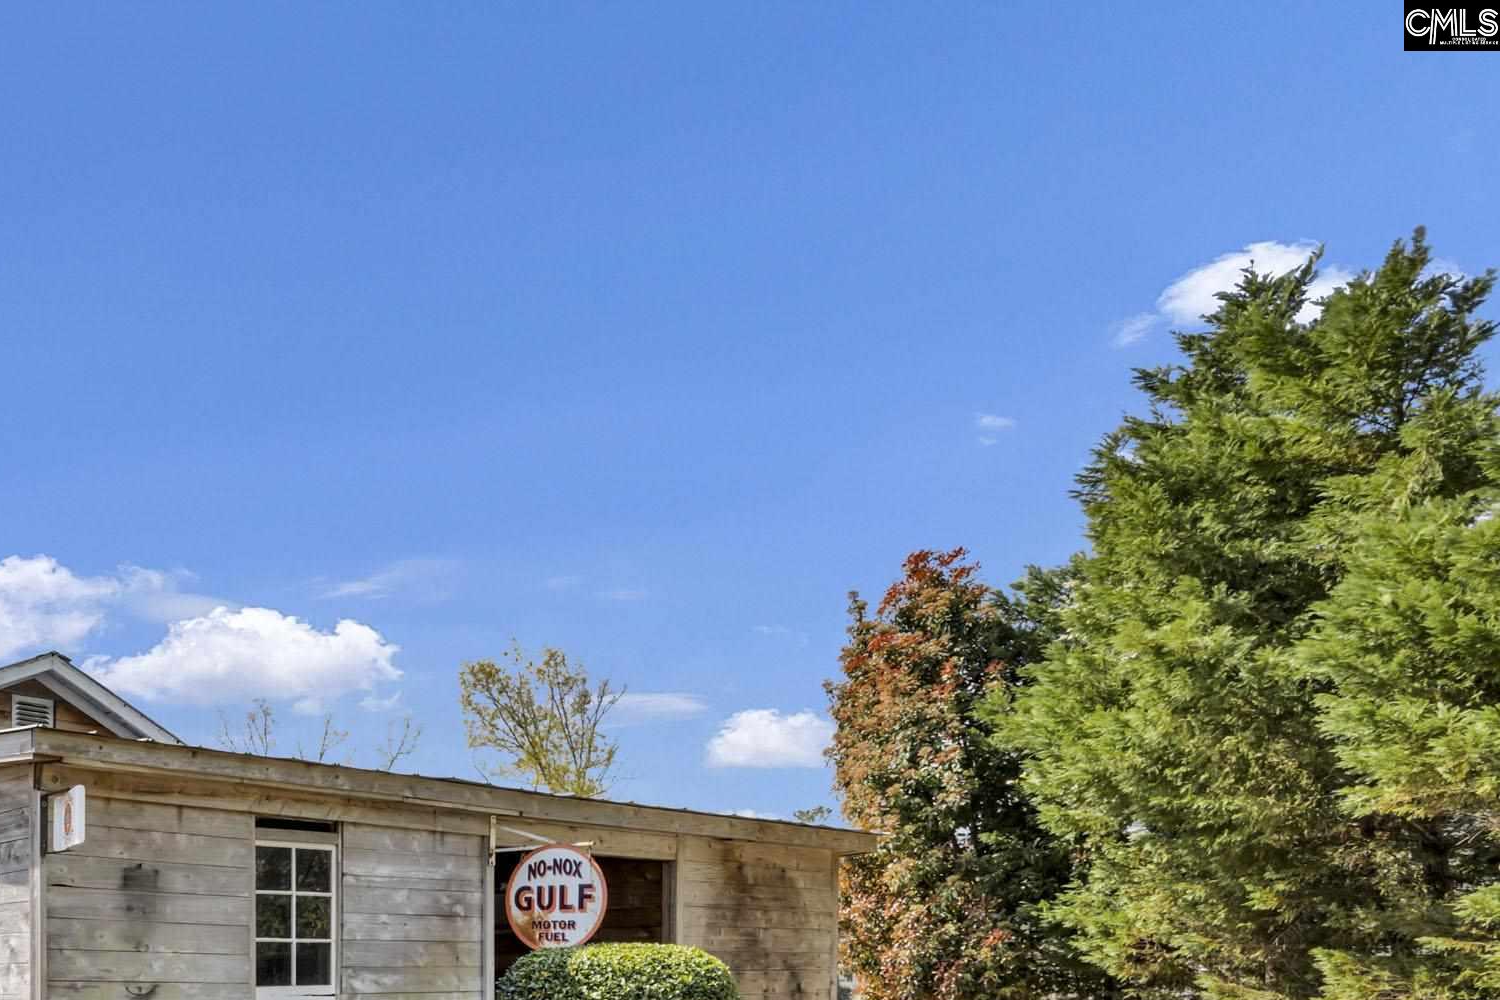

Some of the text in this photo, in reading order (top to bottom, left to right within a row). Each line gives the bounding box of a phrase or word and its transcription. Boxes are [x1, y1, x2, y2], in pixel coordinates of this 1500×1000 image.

[528, 858, 582, 880] NO-NOX
[514, 883, 596, 912] GULF
[531, 920, 576, 930] MOTOR
[538, 932, 569, 942] FUEL
